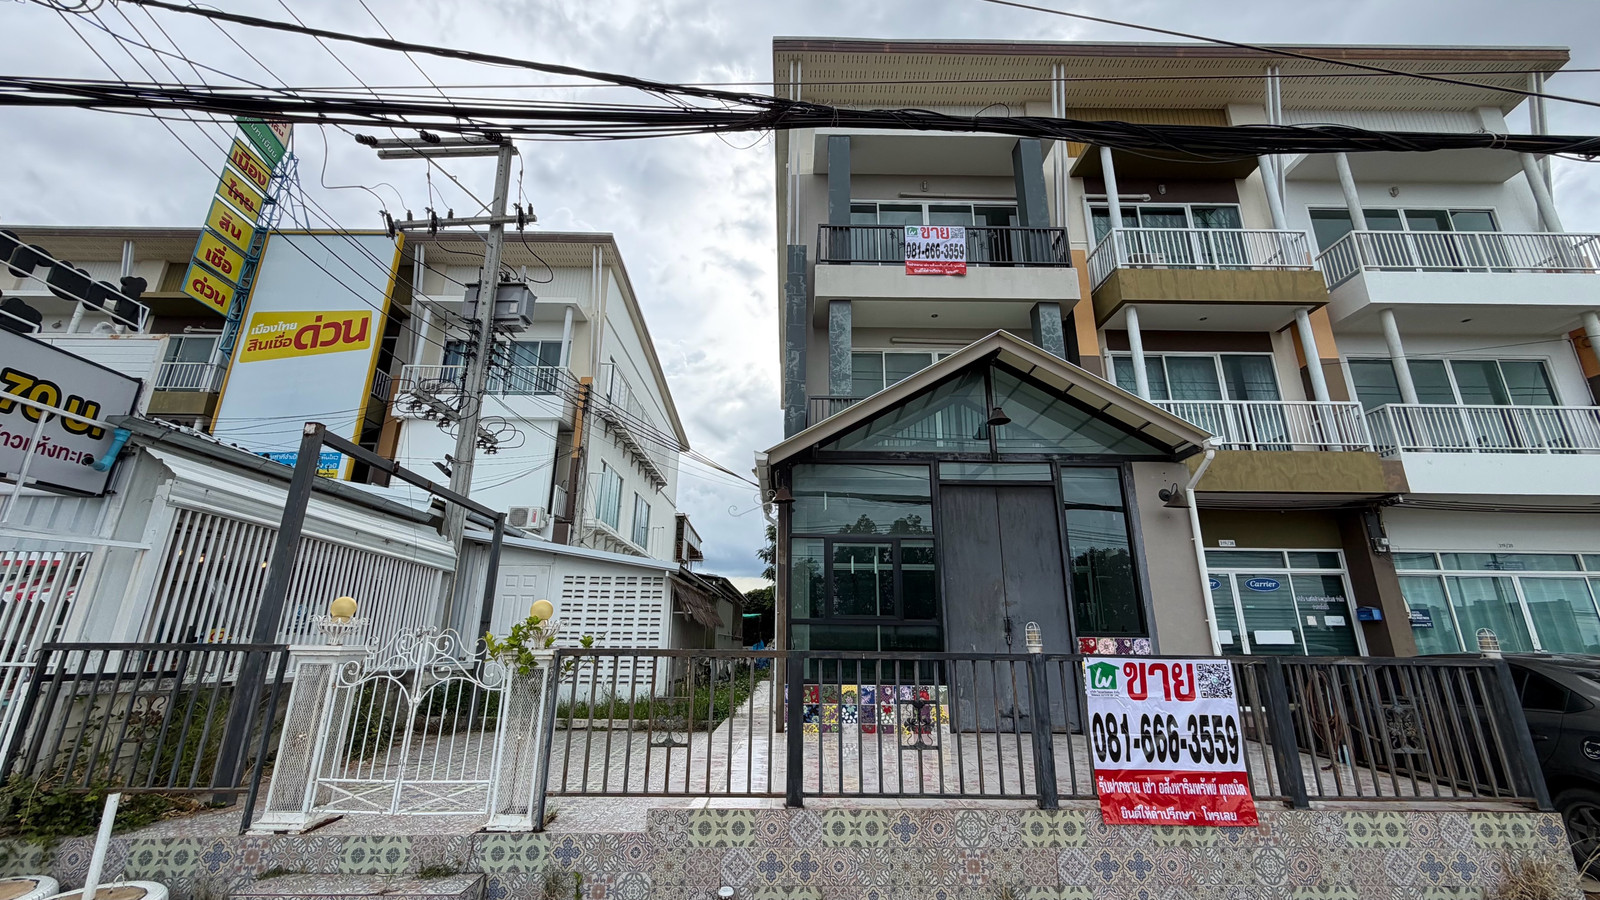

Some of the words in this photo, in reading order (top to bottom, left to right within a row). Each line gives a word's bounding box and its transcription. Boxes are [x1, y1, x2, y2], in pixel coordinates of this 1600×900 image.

[233, 150, 267, 186] เมือง
[228, 177, 254, 212] ไทย
[219, 211, 242, 241] สิน
[920, 226, 950, 239] ขาย
[205, 246, 232, 274] เชื่อ
[906, 242, 965, 260] 081-666-3559
[192, 276, 226, 307] ด่วน
[247, 332, 293, 352] สินเชื่อ
[293, 315, 369, 350] ด่วน
[251, 321, 298, 335] เมืองไทย
[1250, 580, 1277, 588] Carrier
[1123, 661, 1197, 702] ขาย
[1092, 712, 1239, 765] 081-666-3559
[1098, 776, 1140, 794] รับฝากขาย
[1142, 777, 1157, 794] เช่า
[1159, 777, 1217, 796] อสังหาริมทรัพย์
[1219, 779, 1248, 802] ทุกชนิด
[1120, 804, 1196, 821] ยินดีให้คำปรึกษา
[1201, 805, 1238, 822] โทรเลย
